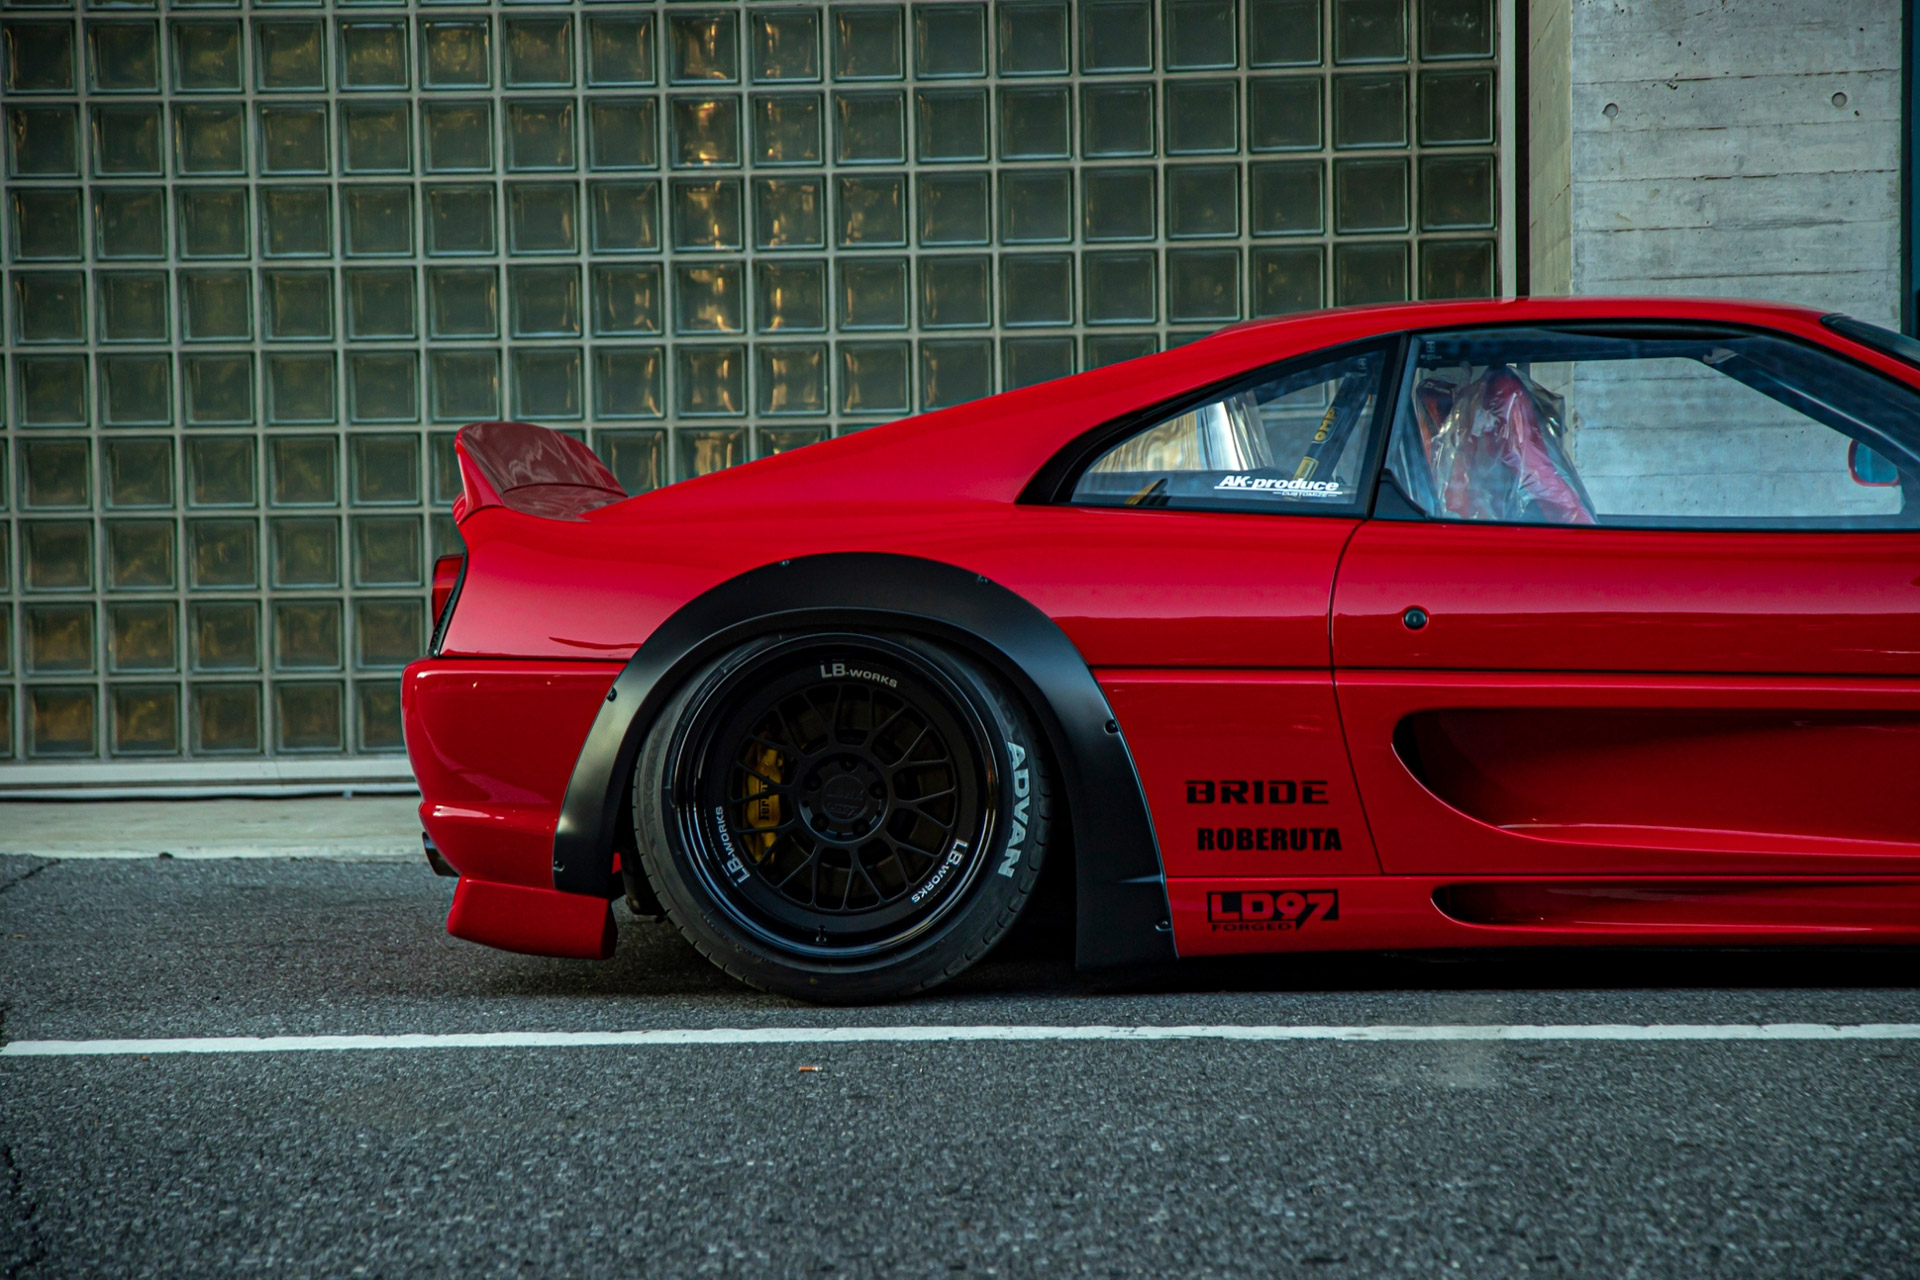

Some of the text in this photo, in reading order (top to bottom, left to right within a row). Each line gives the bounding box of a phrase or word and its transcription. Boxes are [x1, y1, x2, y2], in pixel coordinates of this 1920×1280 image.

[1219, 475, 1339, 491] AK-produce
[820, 663, 898, 689] LB-WORKS
[1184, 780, 1329, 804] BRIDE
[997, 740, 1031, 879] ADVAN
[715, 806, 750, 884] LB-WORKS
[1197, 827, 1342, 851] ROBERUTA
[911, 838, 968, 904] LB-WORKS
[1209, 890, 1337, 921] LD97
[1211, 922, 1292, 931] FORGED
